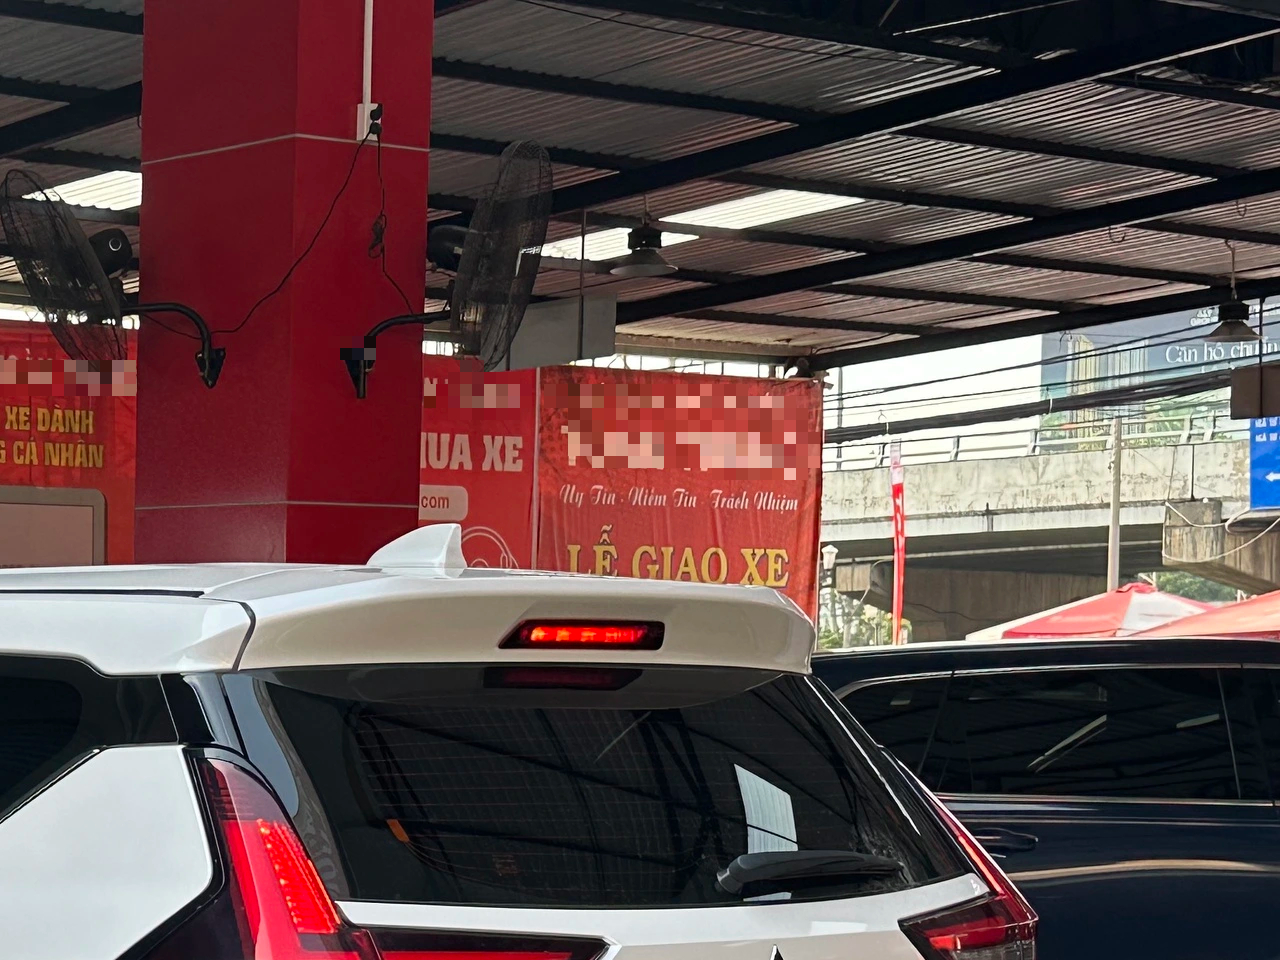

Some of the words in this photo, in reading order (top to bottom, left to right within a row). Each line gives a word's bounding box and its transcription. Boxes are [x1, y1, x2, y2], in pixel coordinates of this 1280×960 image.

[5, 405, 31, 431] XE
[37, 404, 94, 434] DÀNH
[13, 437, 39, 465] CÁ
[44, 439, 105, 468] NHÂN
[482, 435, 524, 472] XE
[567, 523, 618, 577] LỄ
[632, 545, 729, 584] GIAO
[740, 548, 790, 587] XE
